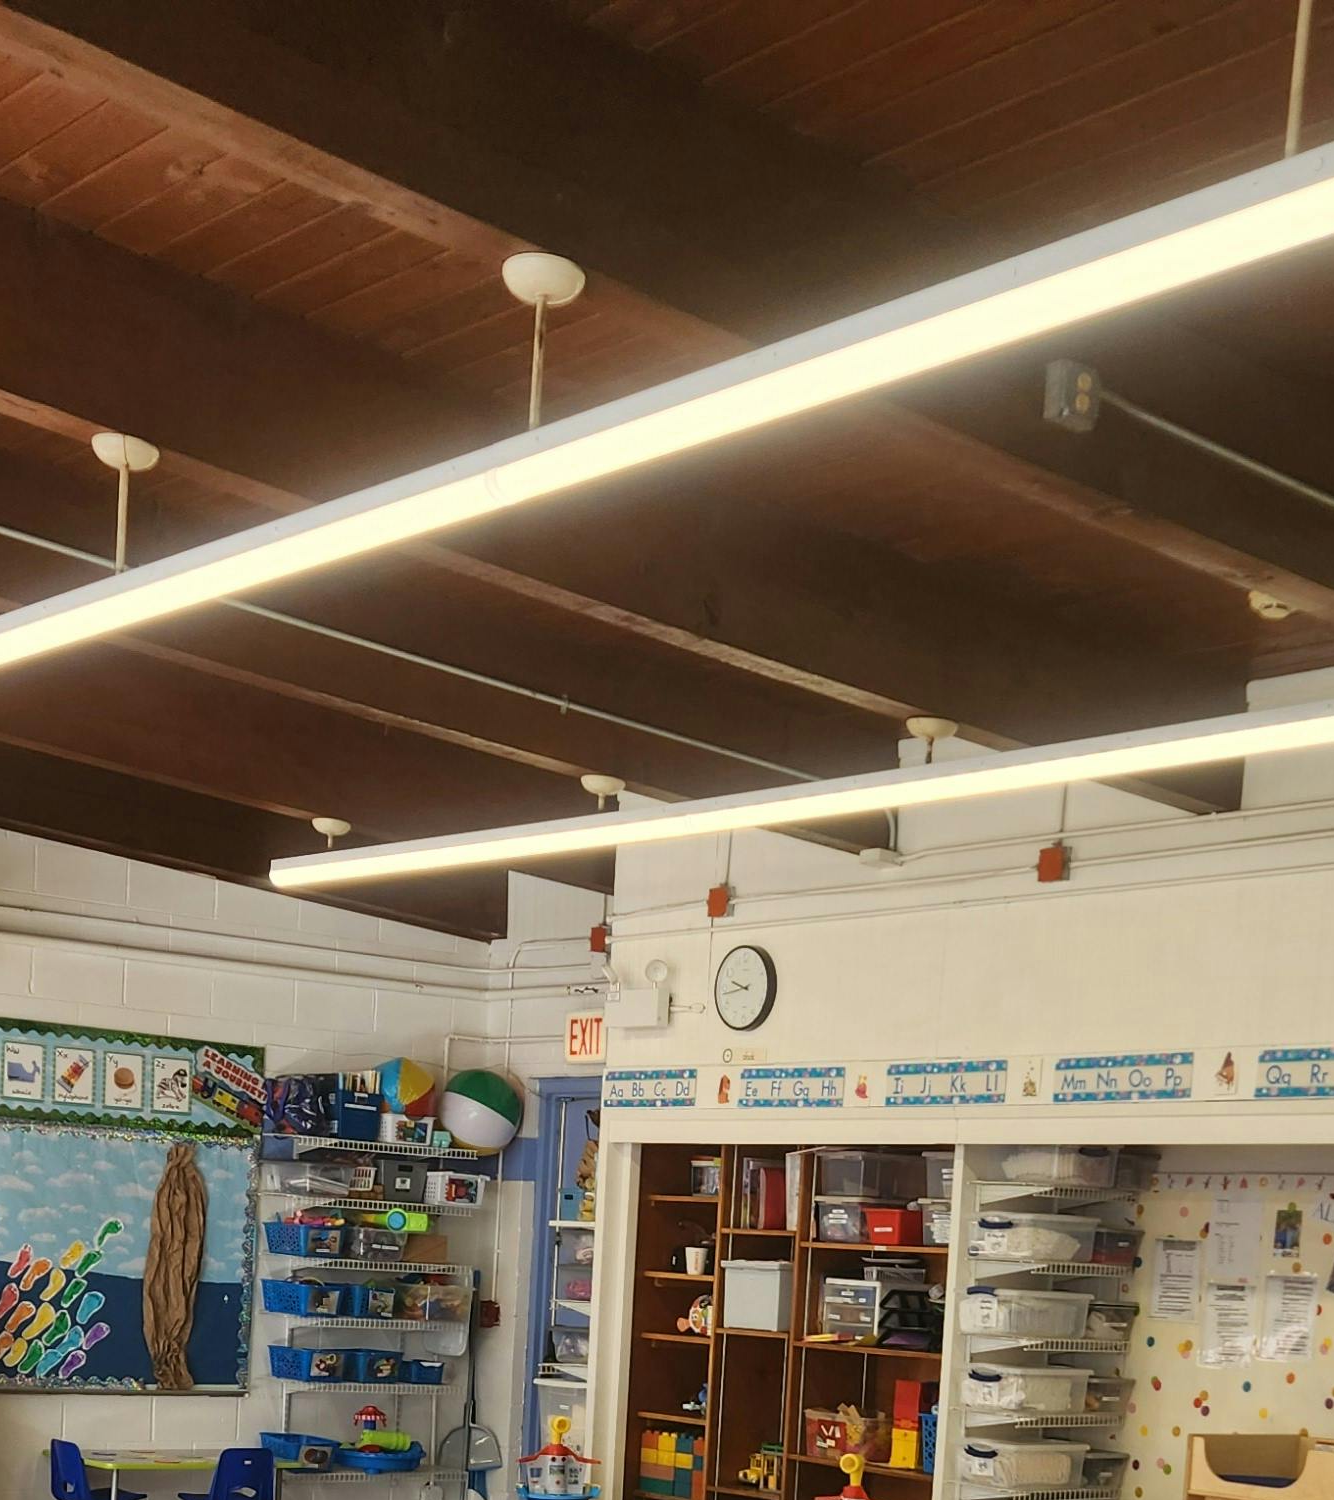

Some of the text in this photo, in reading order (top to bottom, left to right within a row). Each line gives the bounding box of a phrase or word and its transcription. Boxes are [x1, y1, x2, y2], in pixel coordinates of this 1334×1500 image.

[569, 1018, 603, 1056] EXIT
[107, 1056, 119, 1069] Yy
[156, 1060, 166, 1069] Zz
[203, 1047, 262, 1087] LEARNING
[203, 1060, 267, 1101] A JOURNEY!
[893, 1074, 998, 1095] Ii Jj Kk Ll
[1061, 1067, 1182, 1090] Mm Nn Oo Pp
[1266, 1065, 1292, 1086] Qq
[1310, 1063, 1328, 1083] Rr
[610, 1081, 690, 1097] Aa Bb Cc Dd
[745, 1080, 837, 1098] Ee Ff Gg Hh
